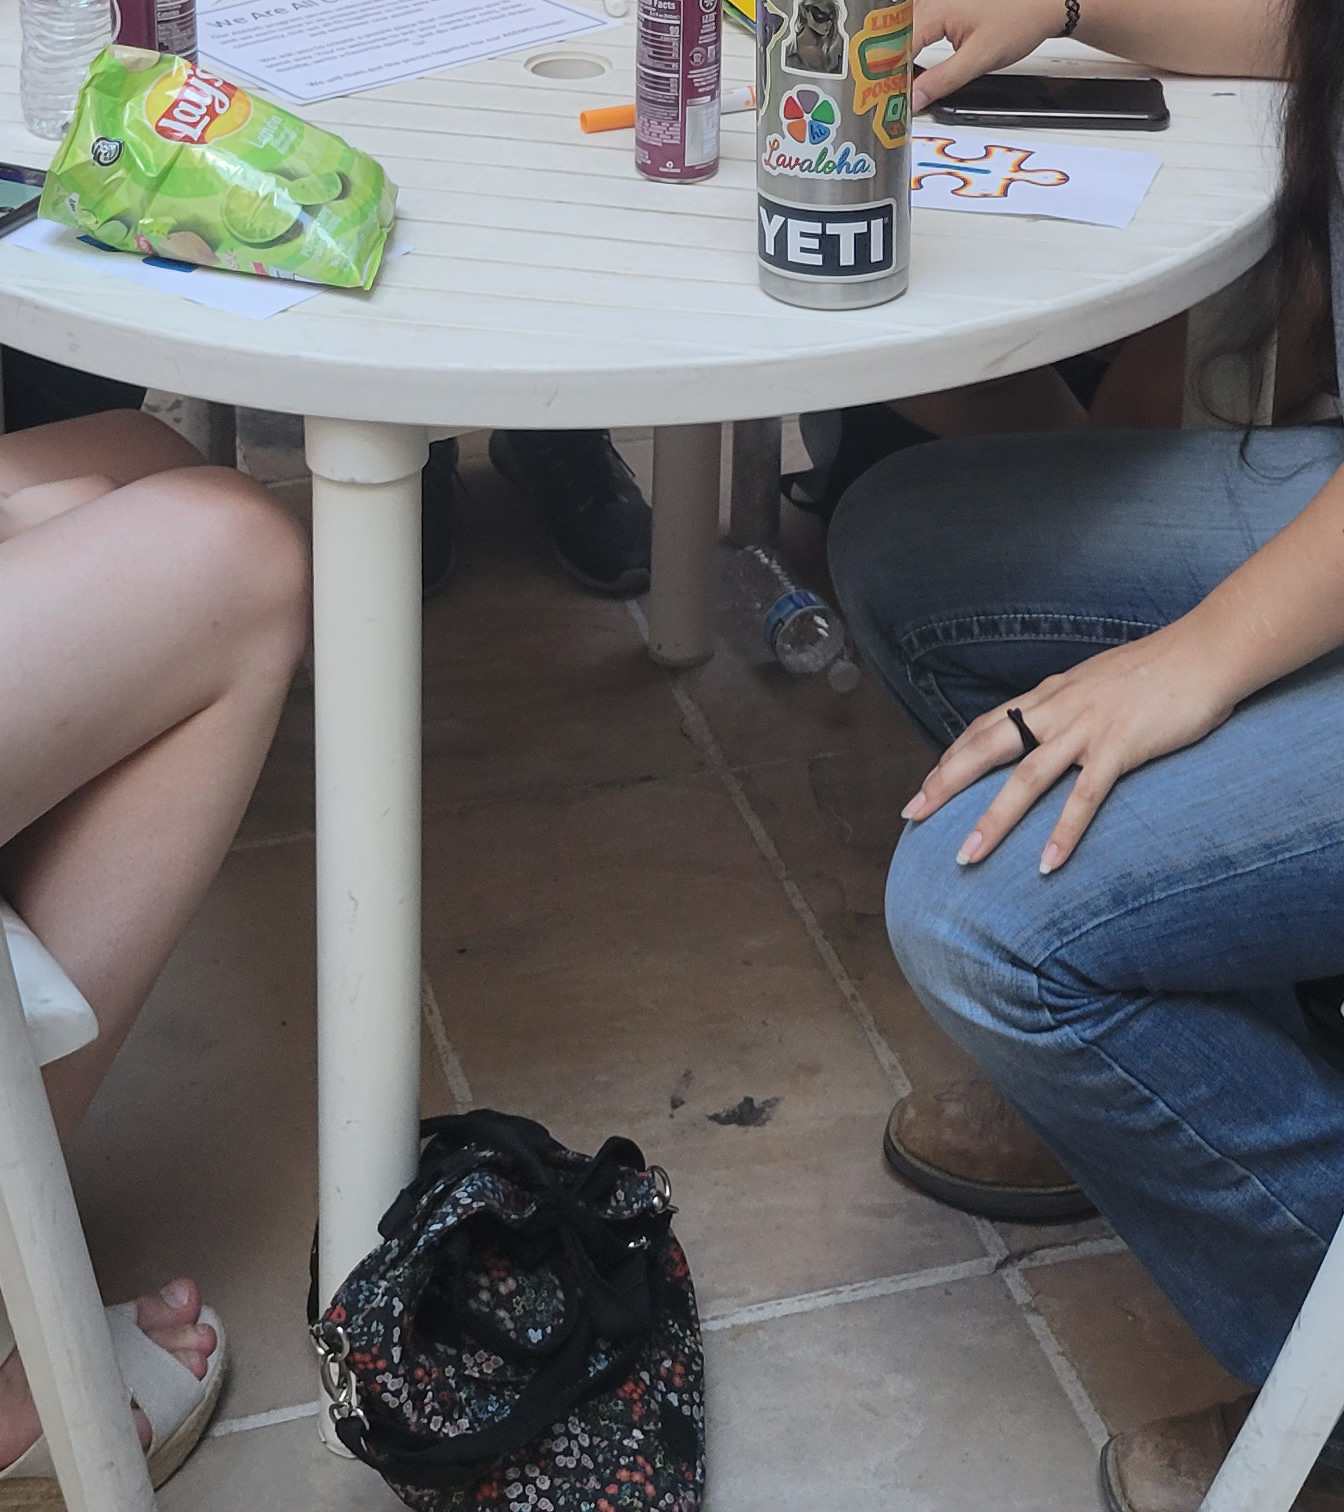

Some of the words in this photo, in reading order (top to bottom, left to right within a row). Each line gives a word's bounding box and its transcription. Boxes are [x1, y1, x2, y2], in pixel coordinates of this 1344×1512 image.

[206, 15, 249, 29] We
[251, 5, 290, 21] Are
[157, 66, 231, 142] Lay's
[809, 123, 827, 140] hi
[764, 138, 871, 176] Lavaloha
[759, 205, 885, 267] YETI
